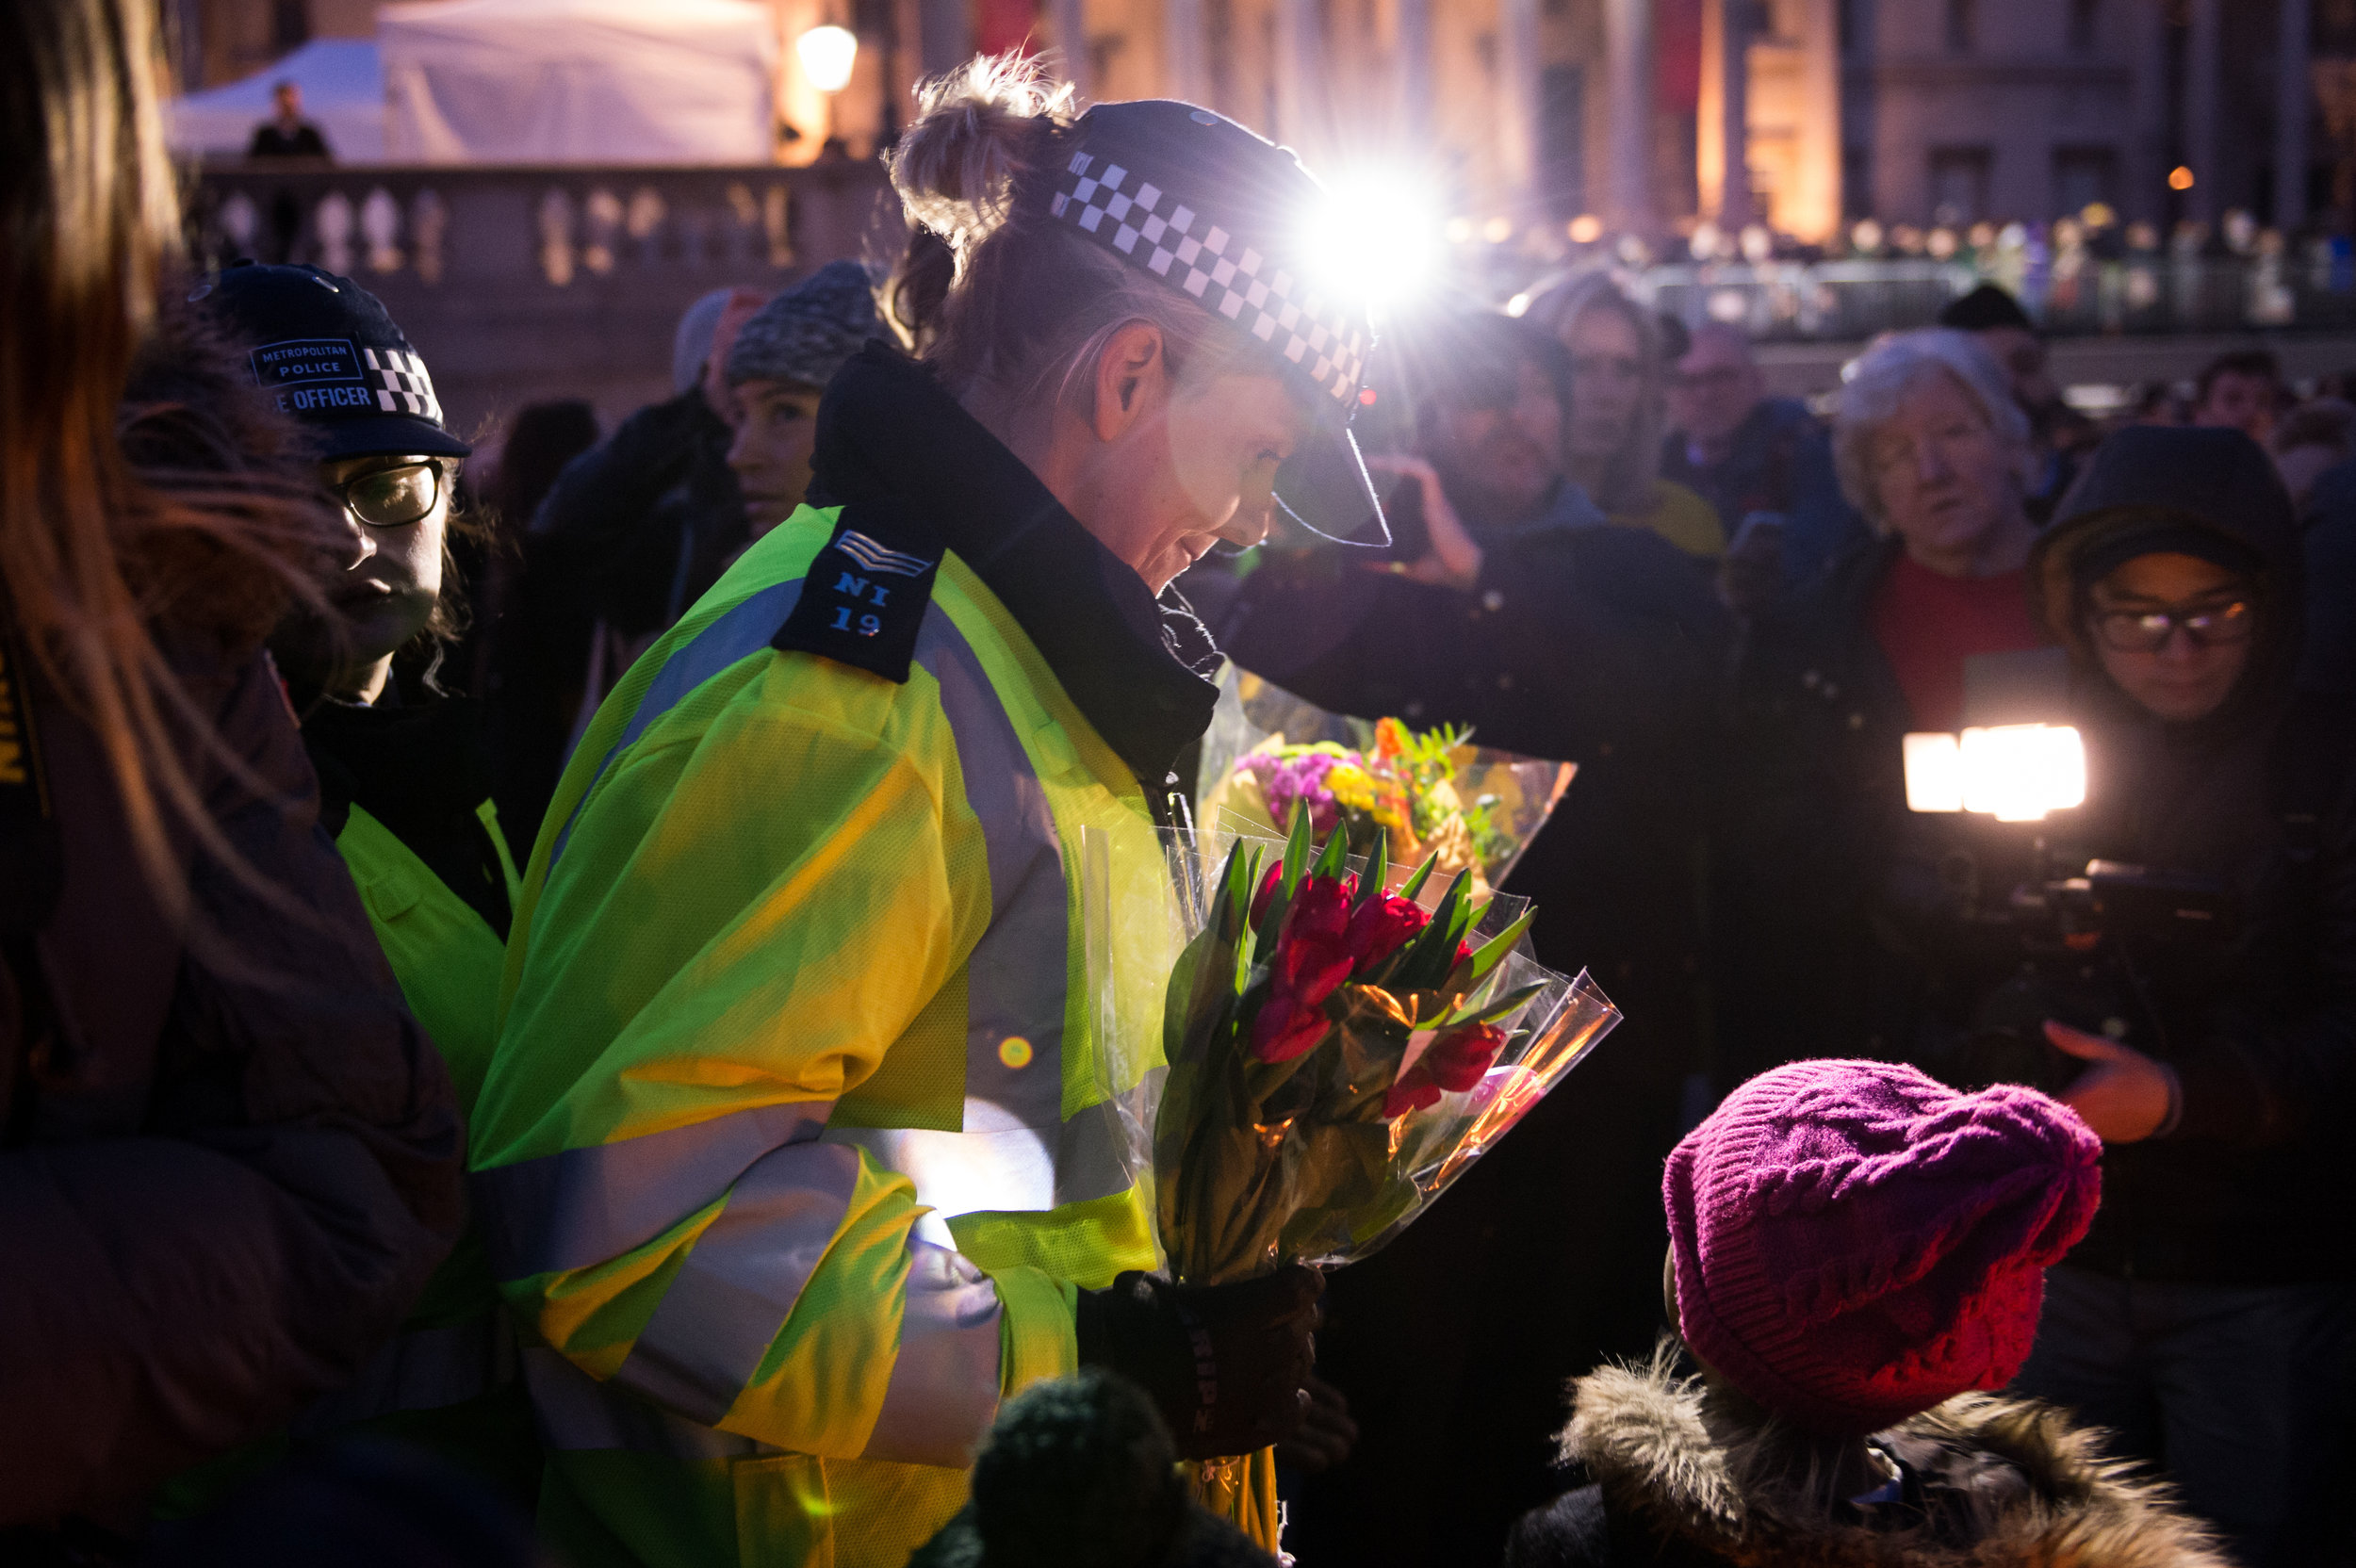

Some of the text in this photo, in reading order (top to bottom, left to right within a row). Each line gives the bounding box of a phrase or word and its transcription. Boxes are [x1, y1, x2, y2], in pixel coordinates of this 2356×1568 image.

[263, 347, 347, 362] METROPOLITAN
[280, 363, 341, 376] POLICE
[294, 387, 371, 409] OFFICER
[833, 571, 890, 606] NI
[830, 606, 880, 637] 19
